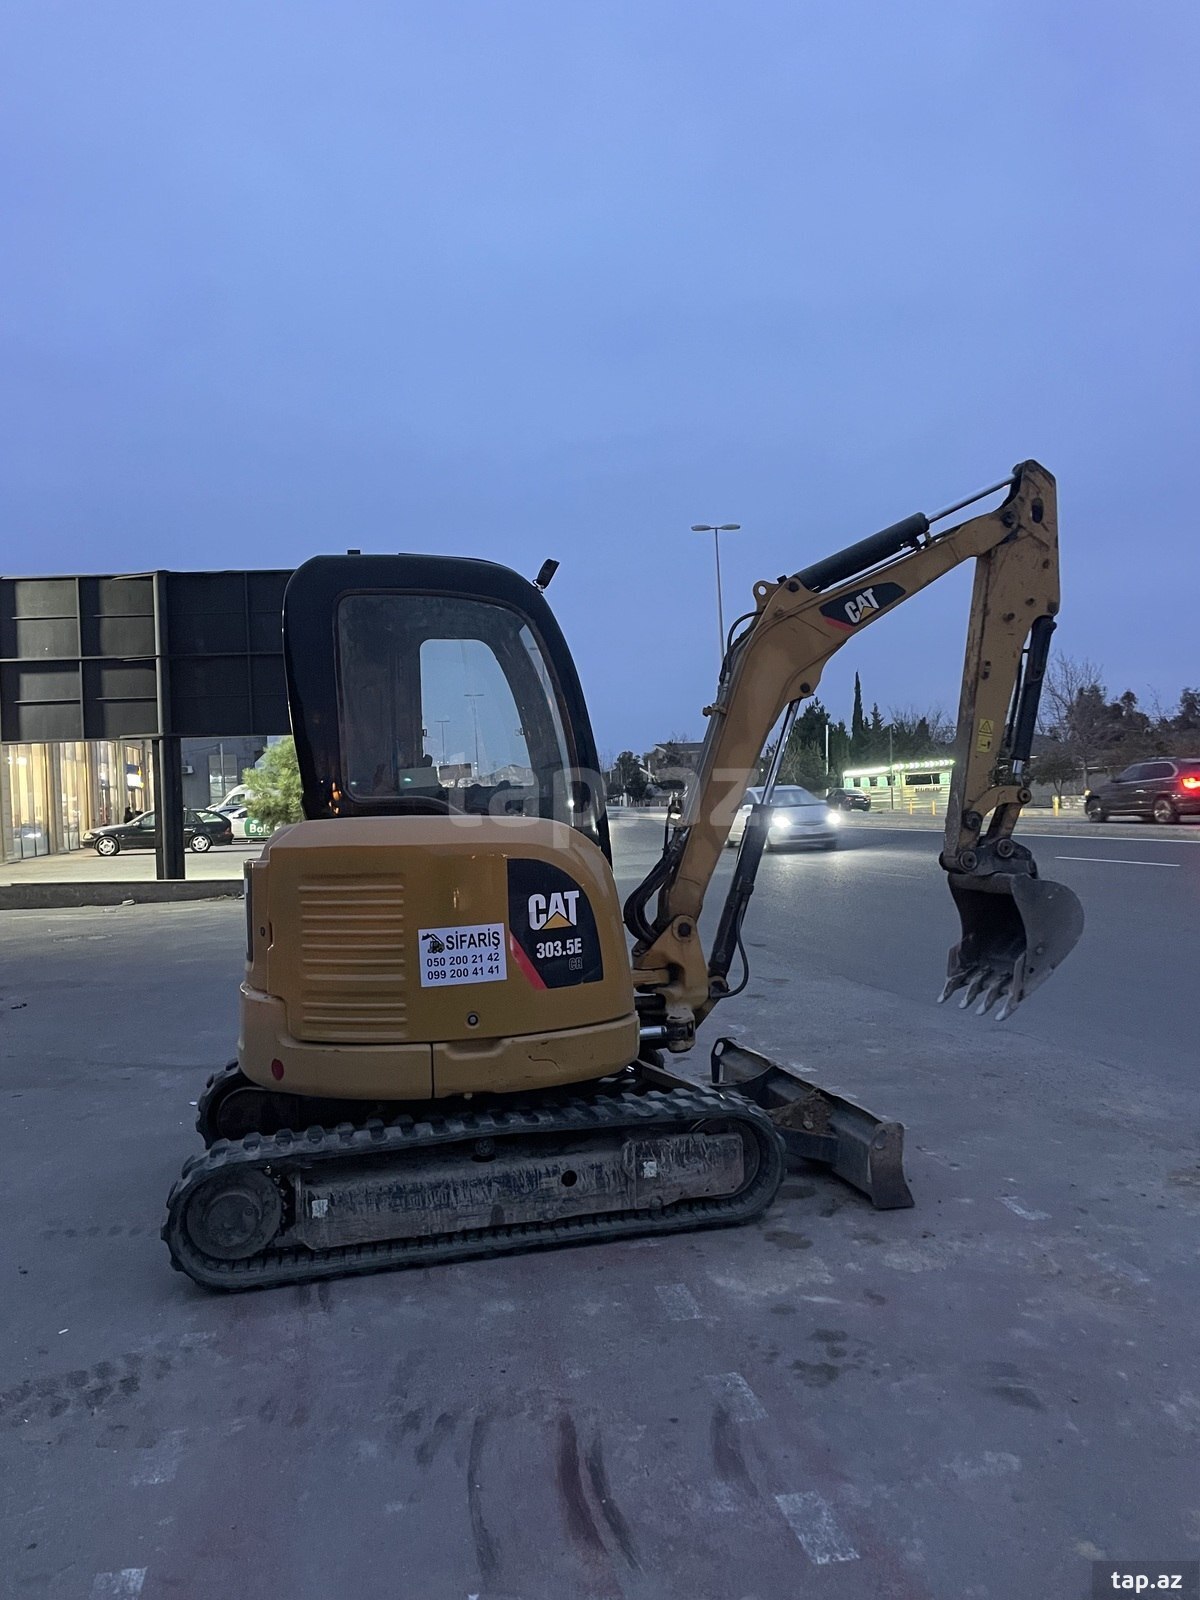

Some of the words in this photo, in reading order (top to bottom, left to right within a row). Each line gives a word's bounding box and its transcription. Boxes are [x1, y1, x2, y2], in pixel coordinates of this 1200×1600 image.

[844, 588, 879, 623] CAT
[528, 890, 580, 931] CAT
[445, 928, 501, 951] SİFARİŞ
[536, 938, 583, 959] 303.5E
[427, 957, 446, 968] 050
[449, 955, 468, 966] 200
[471, 954, 483, 964] 21
[487, 952, 500, 962] 42
[427, 970, 447, 981] 099
[449, 968, 469, 979] 200
[472, 966, 484, 976] 41
[487, 965, 500, 975] 41
